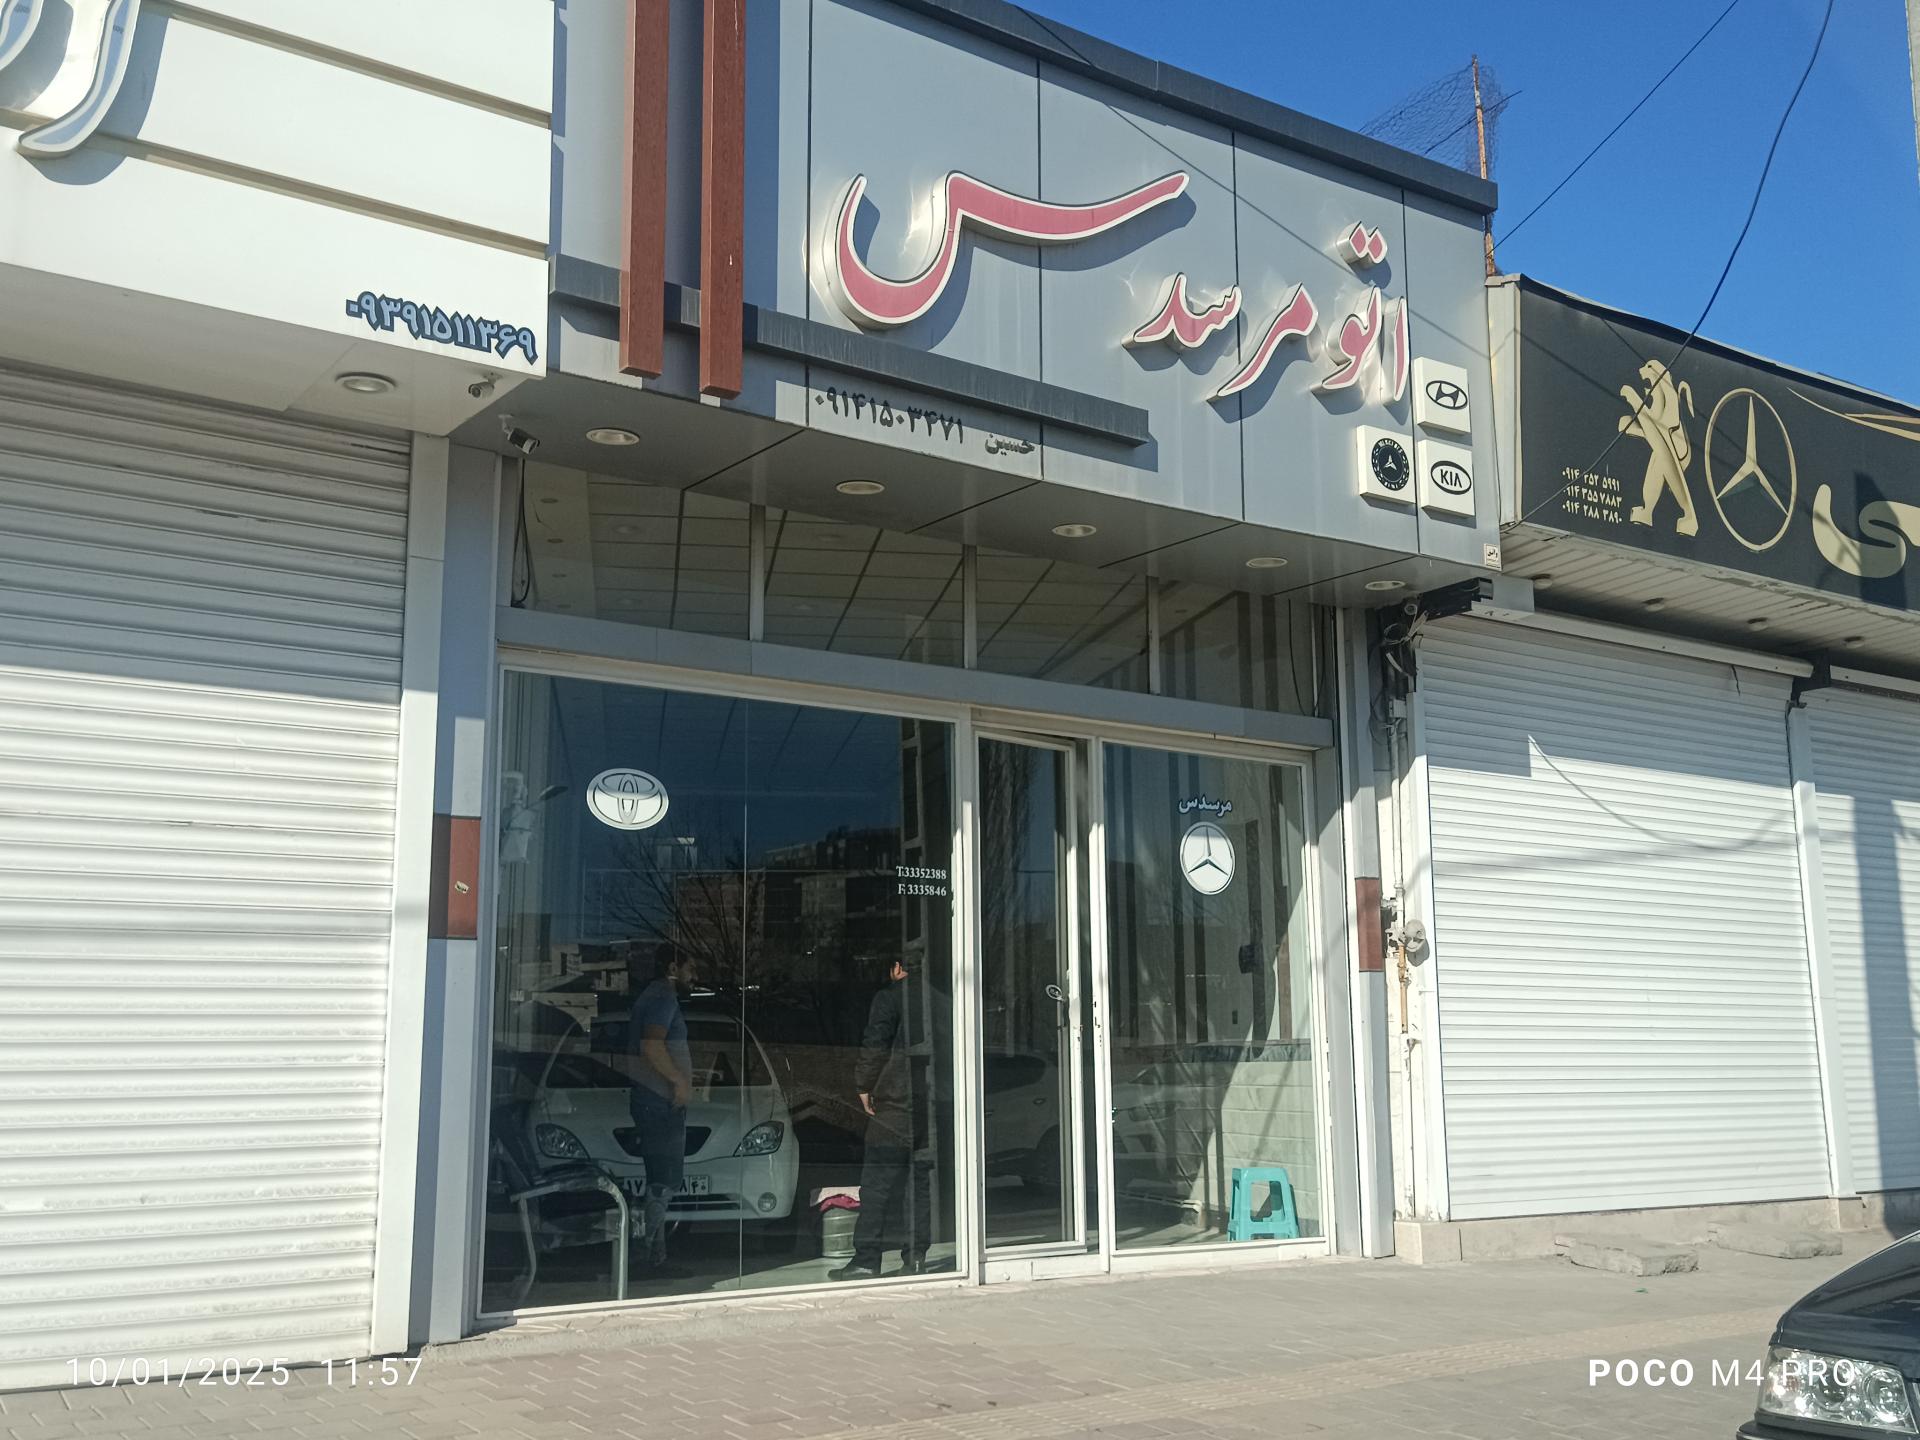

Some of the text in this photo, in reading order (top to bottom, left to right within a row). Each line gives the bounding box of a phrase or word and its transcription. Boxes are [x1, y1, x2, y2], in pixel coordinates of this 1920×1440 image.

[832, 170, 1410, 400] اتو مرسدس
[346, 291, 538, 365] ۰۹۳۹۱۵۱۱۳۶۹
[815, 387, 1035, 456] حسین ۰۹۱۴۱۵۰۳۴۷۱
[1440, 468, 1463, 488] KIA
[1179, 796, 1232, 817] مرسدس
